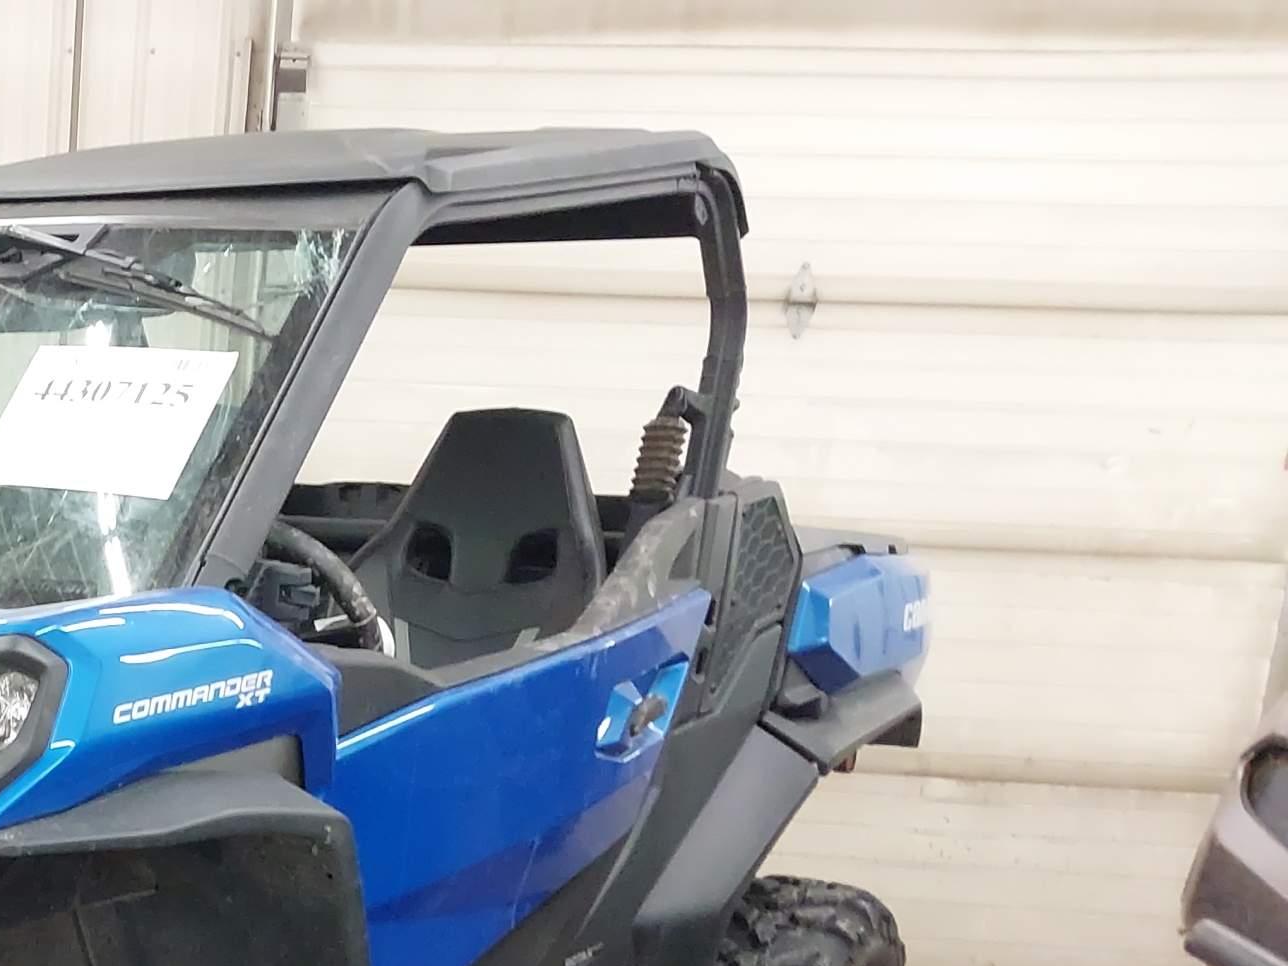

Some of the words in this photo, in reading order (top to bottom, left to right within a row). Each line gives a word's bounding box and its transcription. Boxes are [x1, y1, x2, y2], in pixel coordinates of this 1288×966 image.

[34, 378, 195, 408] 44307125
[113, 669, 273, 725] COMMANDER
[236, 687, 271, 709] XT
